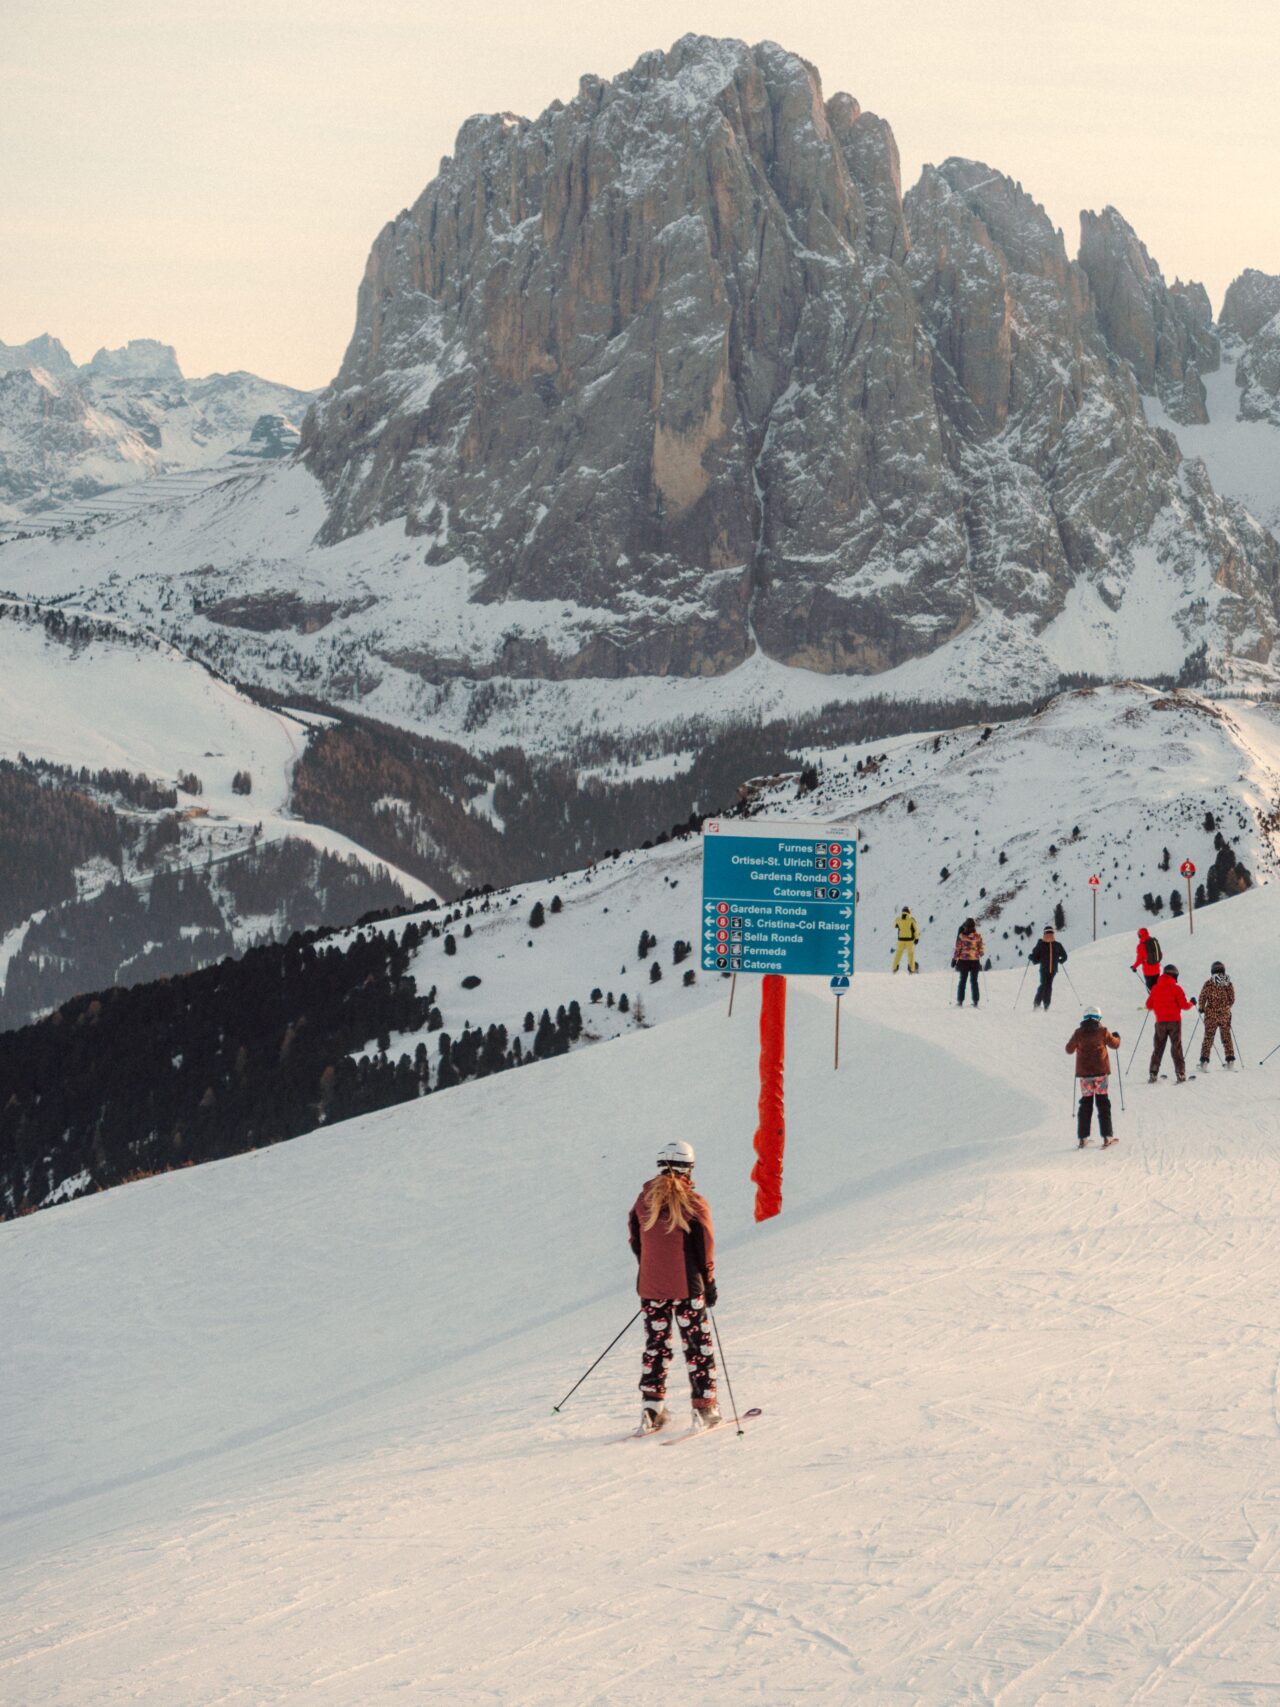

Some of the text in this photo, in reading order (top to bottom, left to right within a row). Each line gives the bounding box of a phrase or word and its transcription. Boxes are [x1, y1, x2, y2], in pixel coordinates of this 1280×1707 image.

[779, 844, 812, 853] Furnes
[732, 856, 780, 866] Ortisei-St.
[784, 858, 812, 867] Ulrich
[751, 872, 792, 881] Gardena
[795, 873, 827, 882] Ronda
[774, 888, 811, 897] Catores
[730, 905, 772, 914] Gardena
[775, 906, 807, 915] Ronda
[757, 921, 815, 930] Cristina-Col
[819, 922, 850, 930] Raiser
[744, 933, 768, 941] Sella
[772, 934, 803, 943] Ronda
[744, 947, 786, 956] Fermeda
[744, 960, 782, 969] Catores
